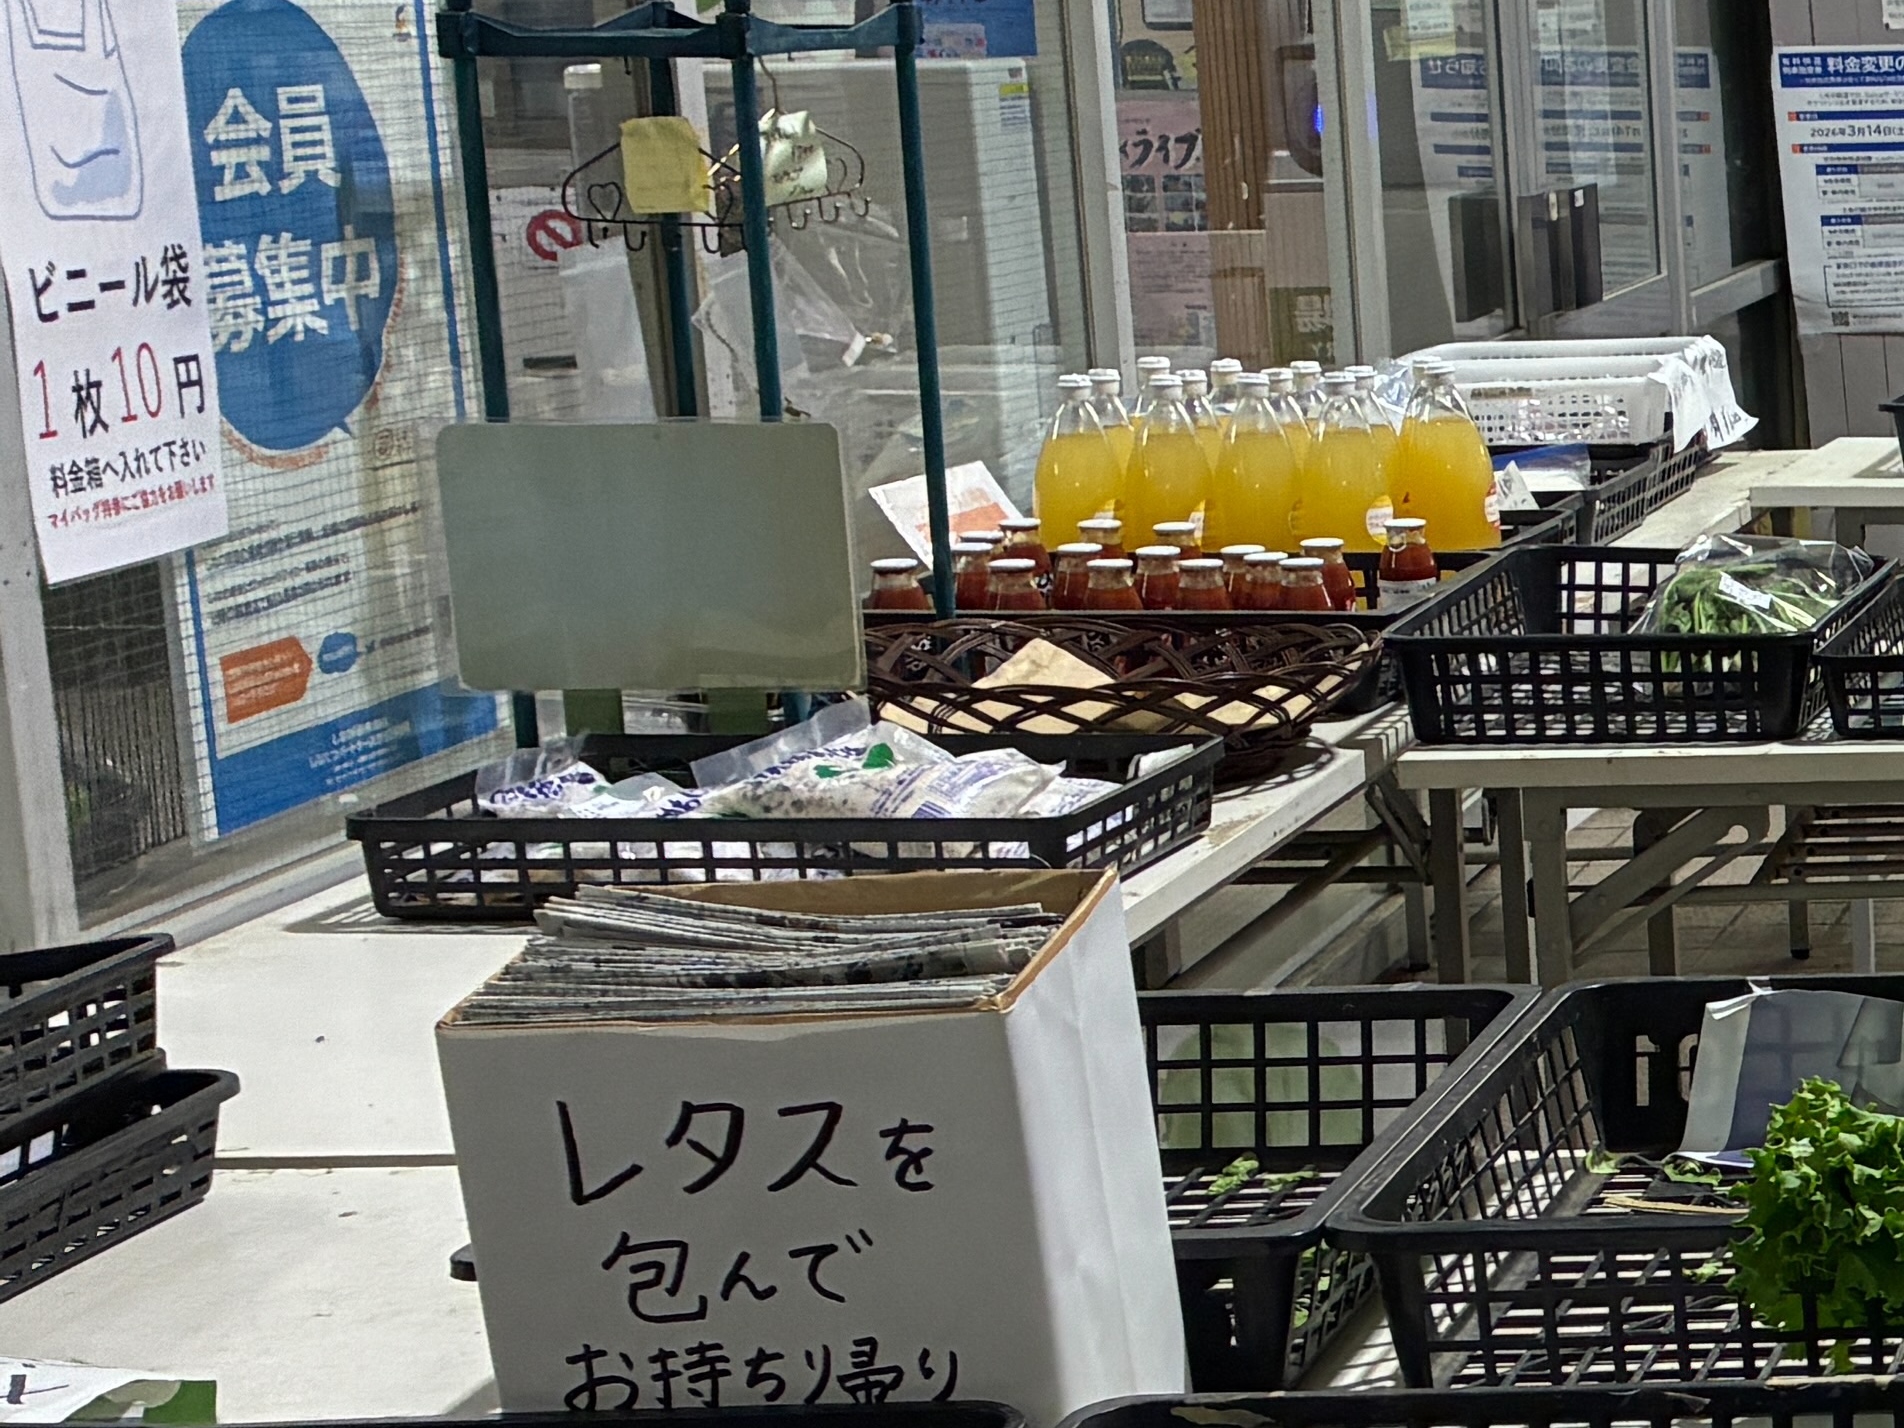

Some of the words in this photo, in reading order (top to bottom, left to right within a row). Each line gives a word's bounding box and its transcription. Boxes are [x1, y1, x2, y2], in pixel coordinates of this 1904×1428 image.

[204, 84, 342, 202] 会員
[29, 243, 192, 323] ビニール袋
[200, 224, 382, 355] 募集中
[50, 437, 206, 498] 料金箱へ入れて下さい
[556, 1099, 938, 1207] レタスを
[600, 1228, 873, 1324] 包んで
[563, 1336, 959, 1412] お持ち帰り
